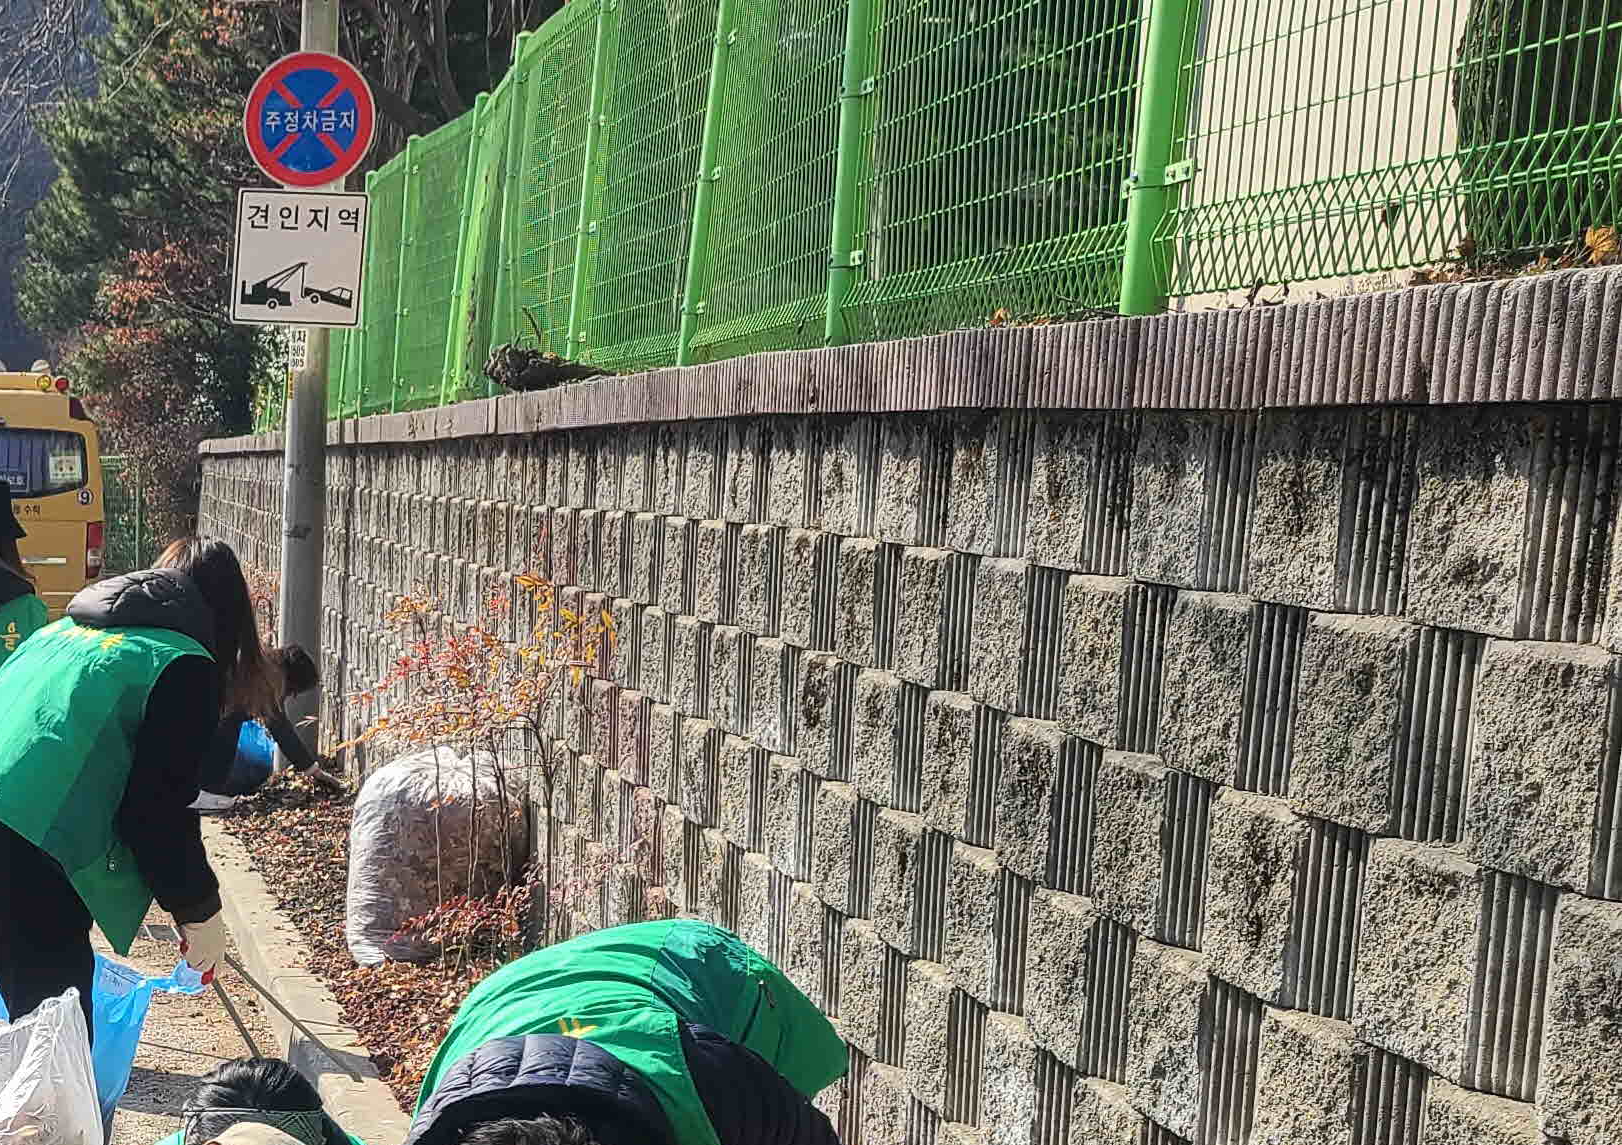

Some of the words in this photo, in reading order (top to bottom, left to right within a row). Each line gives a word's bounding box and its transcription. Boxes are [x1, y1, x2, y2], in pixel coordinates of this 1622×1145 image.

[265, 109, 355, 133] 주정차금지
[247, 203, 360, 233] 견인지역
[81, 491, 90, 504] 9
